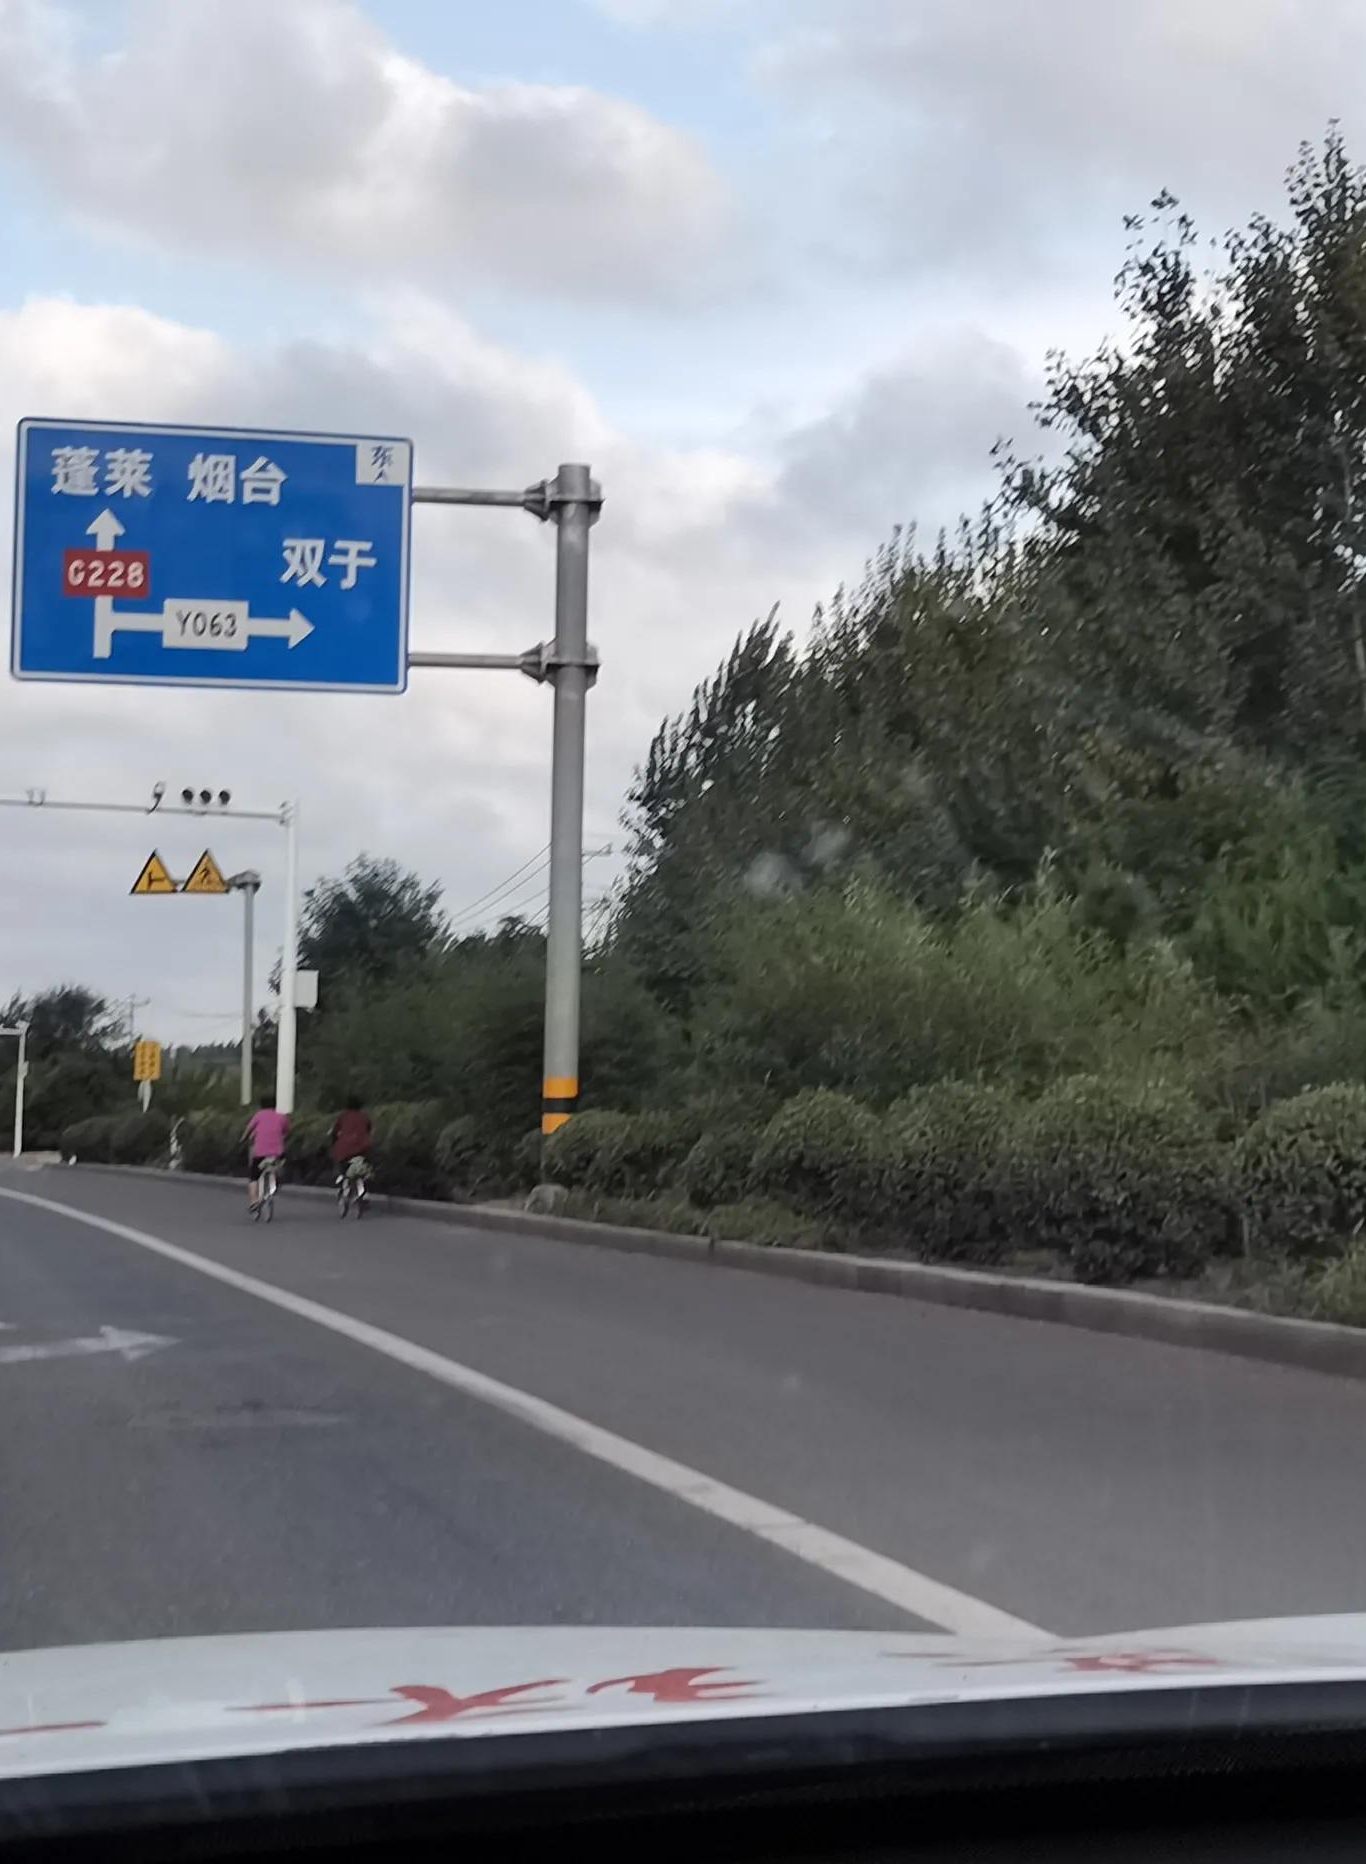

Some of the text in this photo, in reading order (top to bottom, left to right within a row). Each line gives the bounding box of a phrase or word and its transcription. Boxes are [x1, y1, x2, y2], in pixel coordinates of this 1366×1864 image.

[50, 445, 288, 507] 蓬莱 烟台
[67, 559, 146, 589] G228
[279, 537, 378, 590] 双于
[175, 609, 239, 639] Y063
